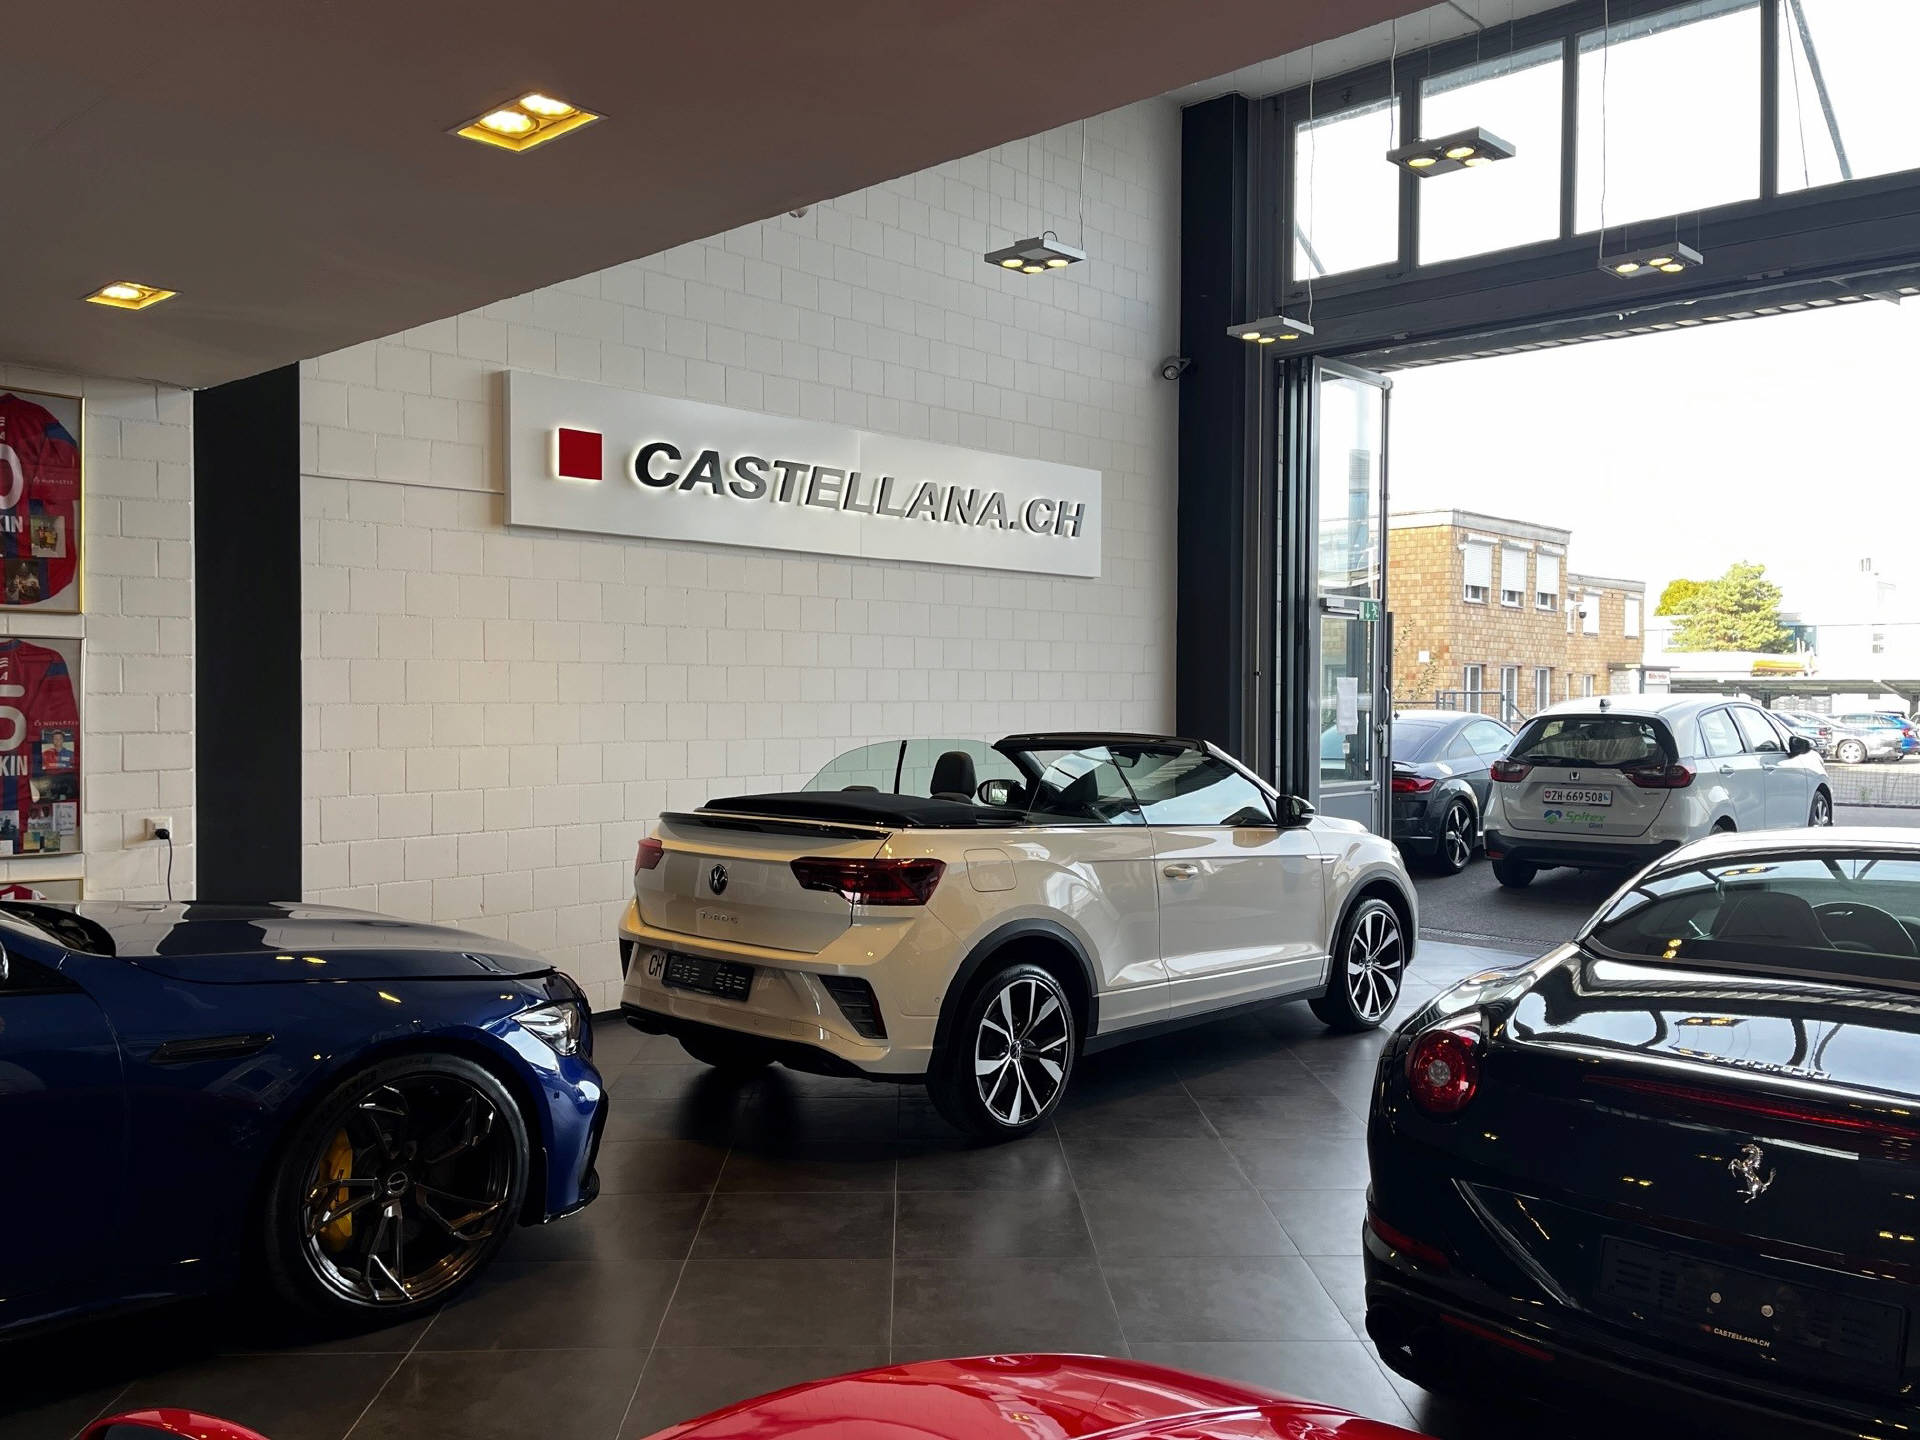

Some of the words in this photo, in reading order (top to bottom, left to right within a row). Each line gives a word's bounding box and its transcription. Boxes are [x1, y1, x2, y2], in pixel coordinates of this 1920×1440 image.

[635, 442, 1086, 538] CASTELLANA.CH
[648, 953, 665, 978] CH
[1713, 1327, 1770, 1348] CASTELLANA.CH
